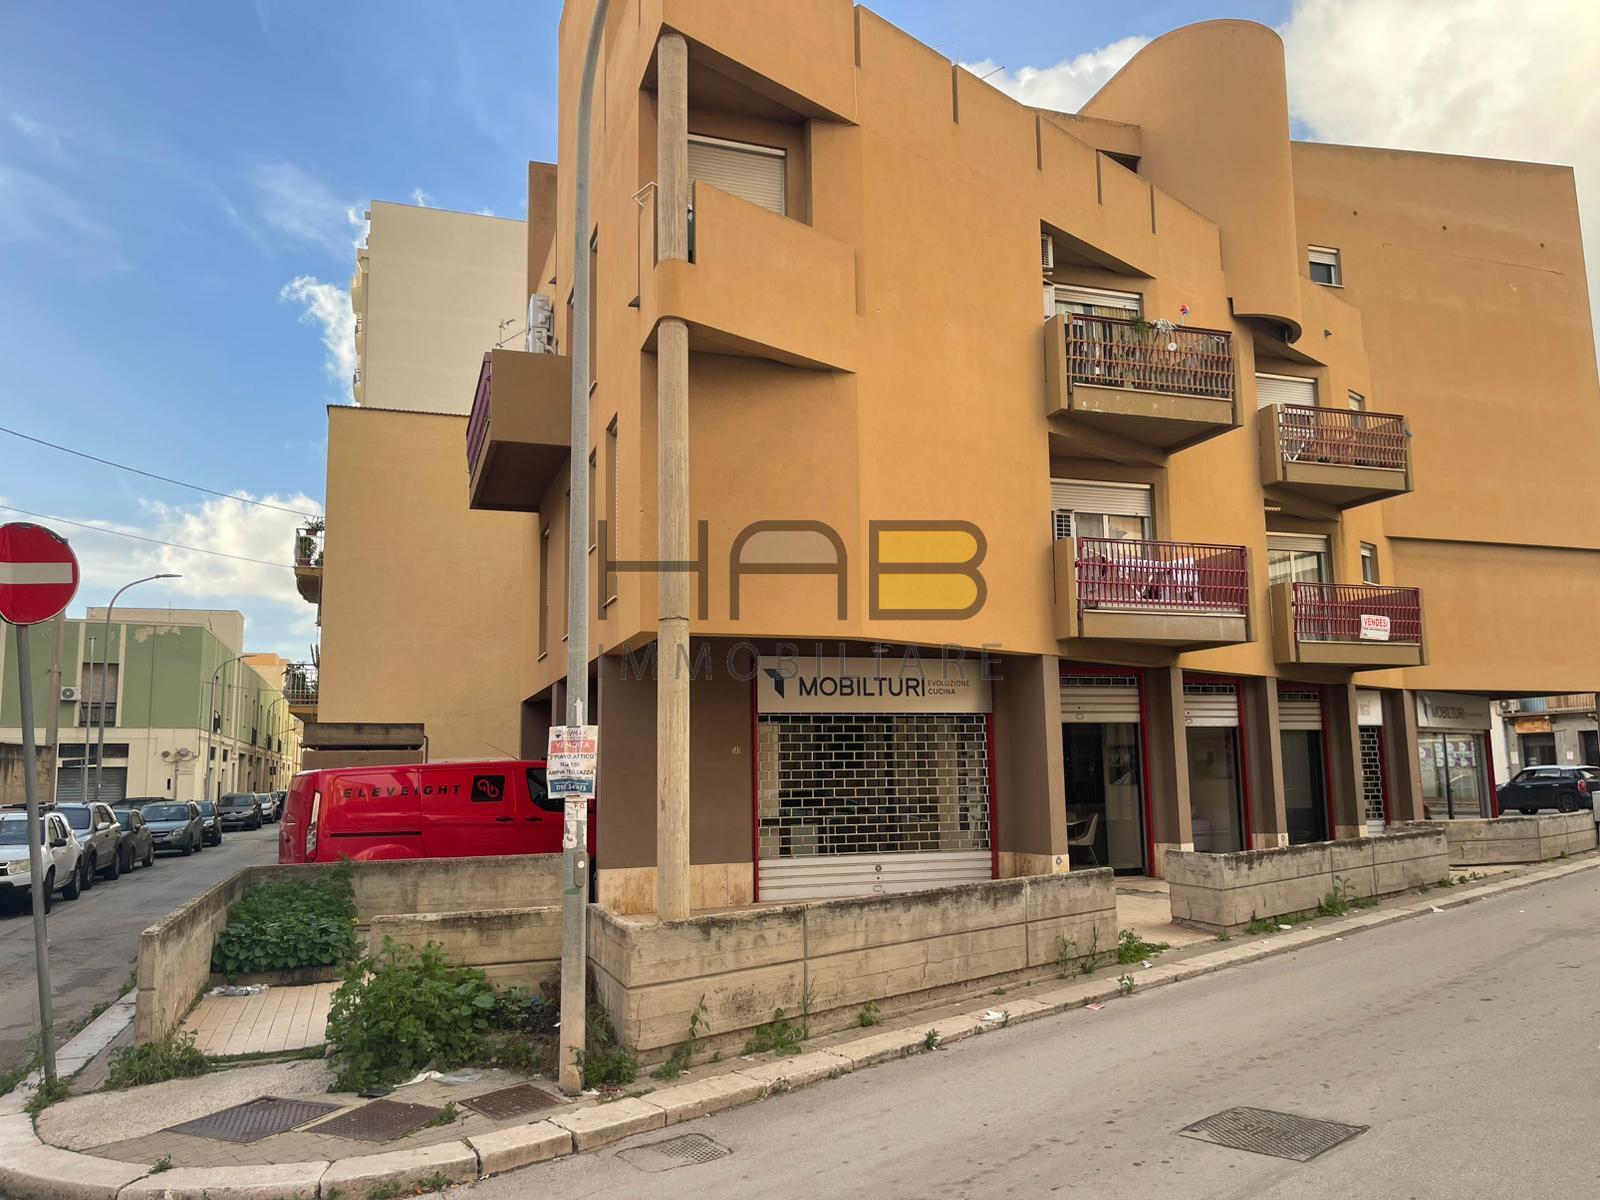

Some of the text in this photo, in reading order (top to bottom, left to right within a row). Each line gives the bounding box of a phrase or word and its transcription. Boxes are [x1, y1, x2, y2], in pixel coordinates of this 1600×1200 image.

[799, 676, 926, 697] MOBILTURI
[927, 687, 956, 695] CUCINA
[343, 784, 462, 799] ELEVEIGHT
